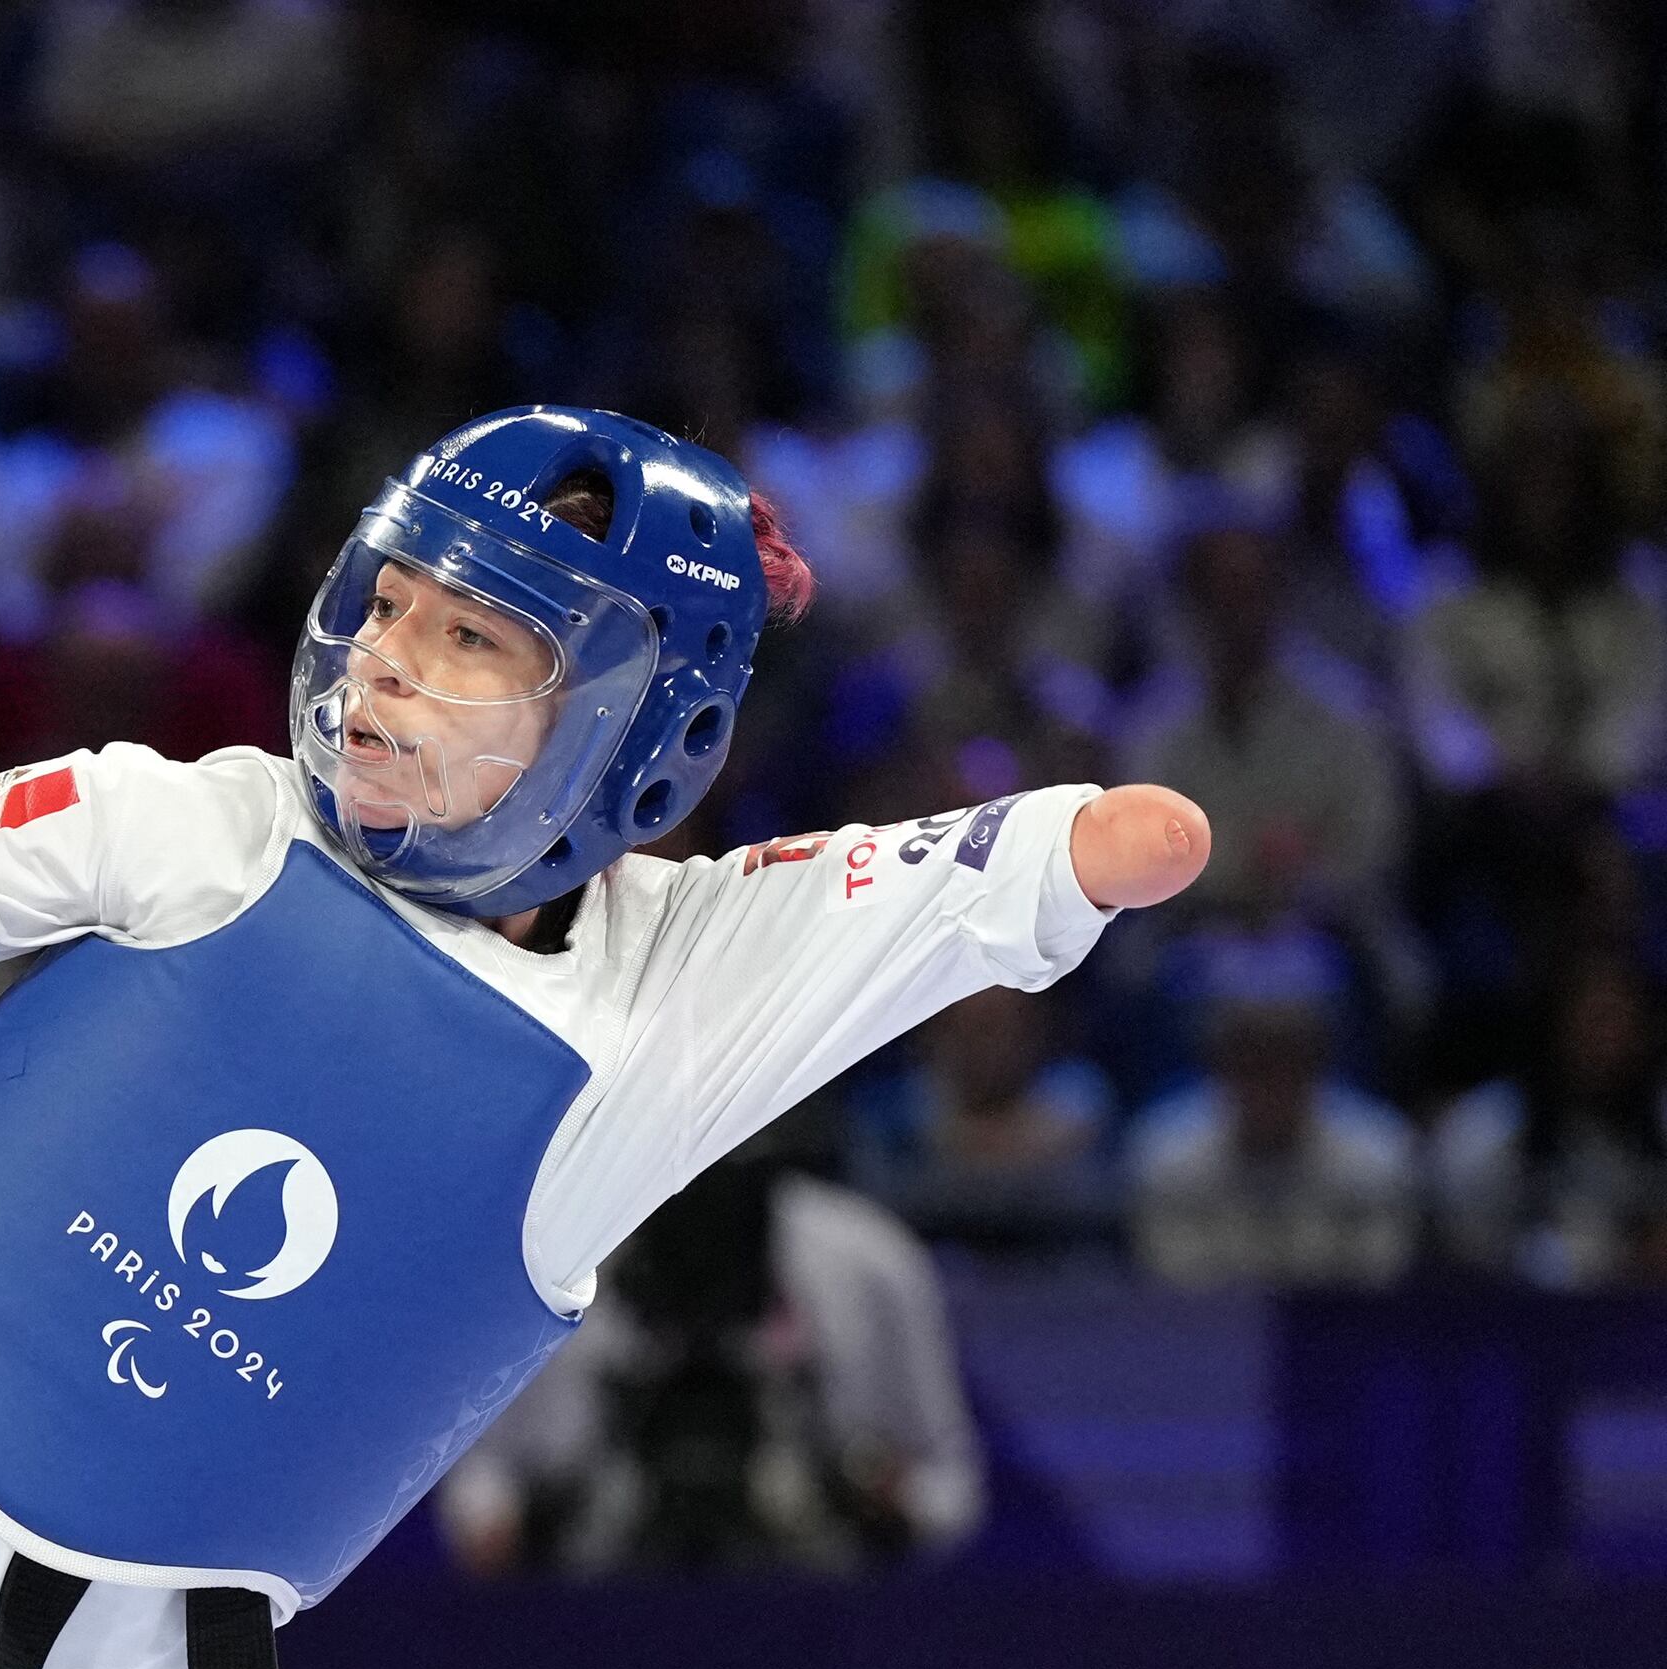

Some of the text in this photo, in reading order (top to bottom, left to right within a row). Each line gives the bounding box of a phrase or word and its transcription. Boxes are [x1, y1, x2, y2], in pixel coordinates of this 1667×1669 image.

[483, 481, 554, 533] 2024
[686, 561, 740, 591] KPNP
[67, 1210, 284, 1400] PARIS 2024
